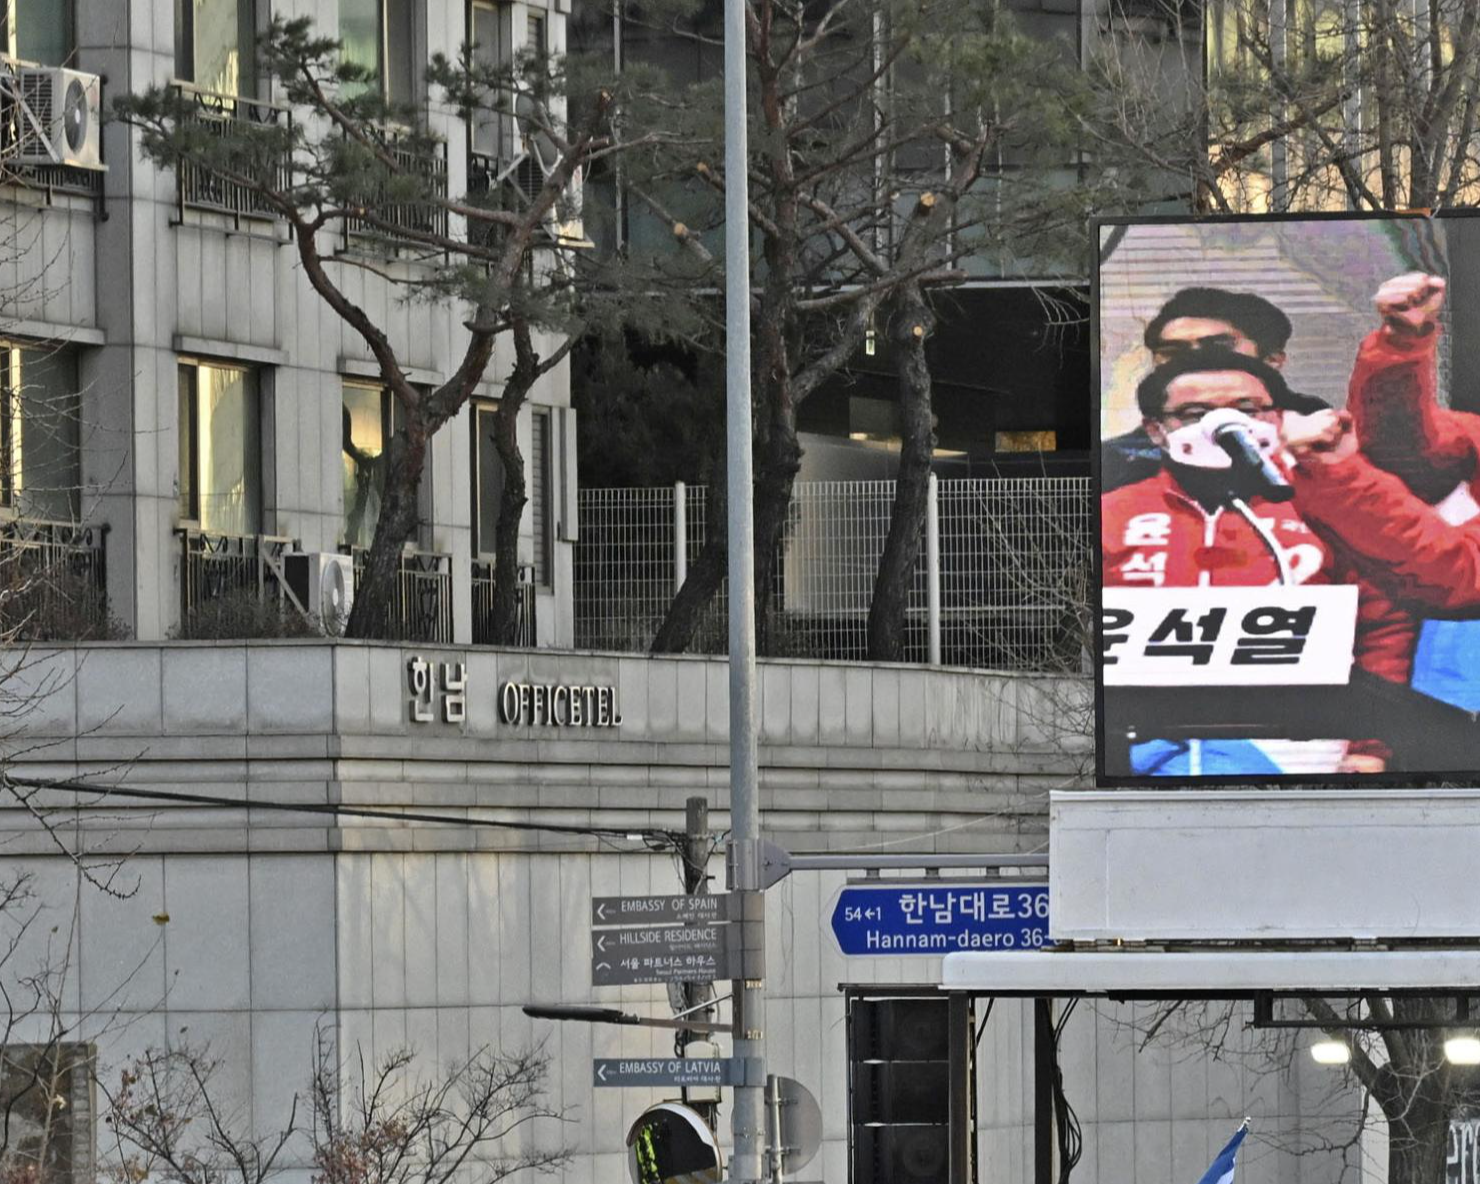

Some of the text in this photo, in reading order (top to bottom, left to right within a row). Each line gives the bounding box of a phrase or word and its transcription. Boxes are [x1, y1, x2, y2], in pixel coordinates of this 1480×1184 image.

[1120, 512, 1172, 586] 윤석
[408, 656, 623, 726] 한남 OFFICETEL
[621, 900, 665, 912] EMBASSY
[671, 899, 685, 910] OF
[689, 898, 717, 910] SPAIN
[845, 907, 861, 921] 54
[620, 928, 717, 944] HILLSIDE RESIDENCE
[866, 928, 1015, 948] Hannam-daero
[620, 955, 716, 970] 서울 파트너스 하우스
[619, 1062, 664, 1074] EMBASSY
[668, 1061, 681, 1073] OF
[685, 1060, 721, 1073] LATVIA
